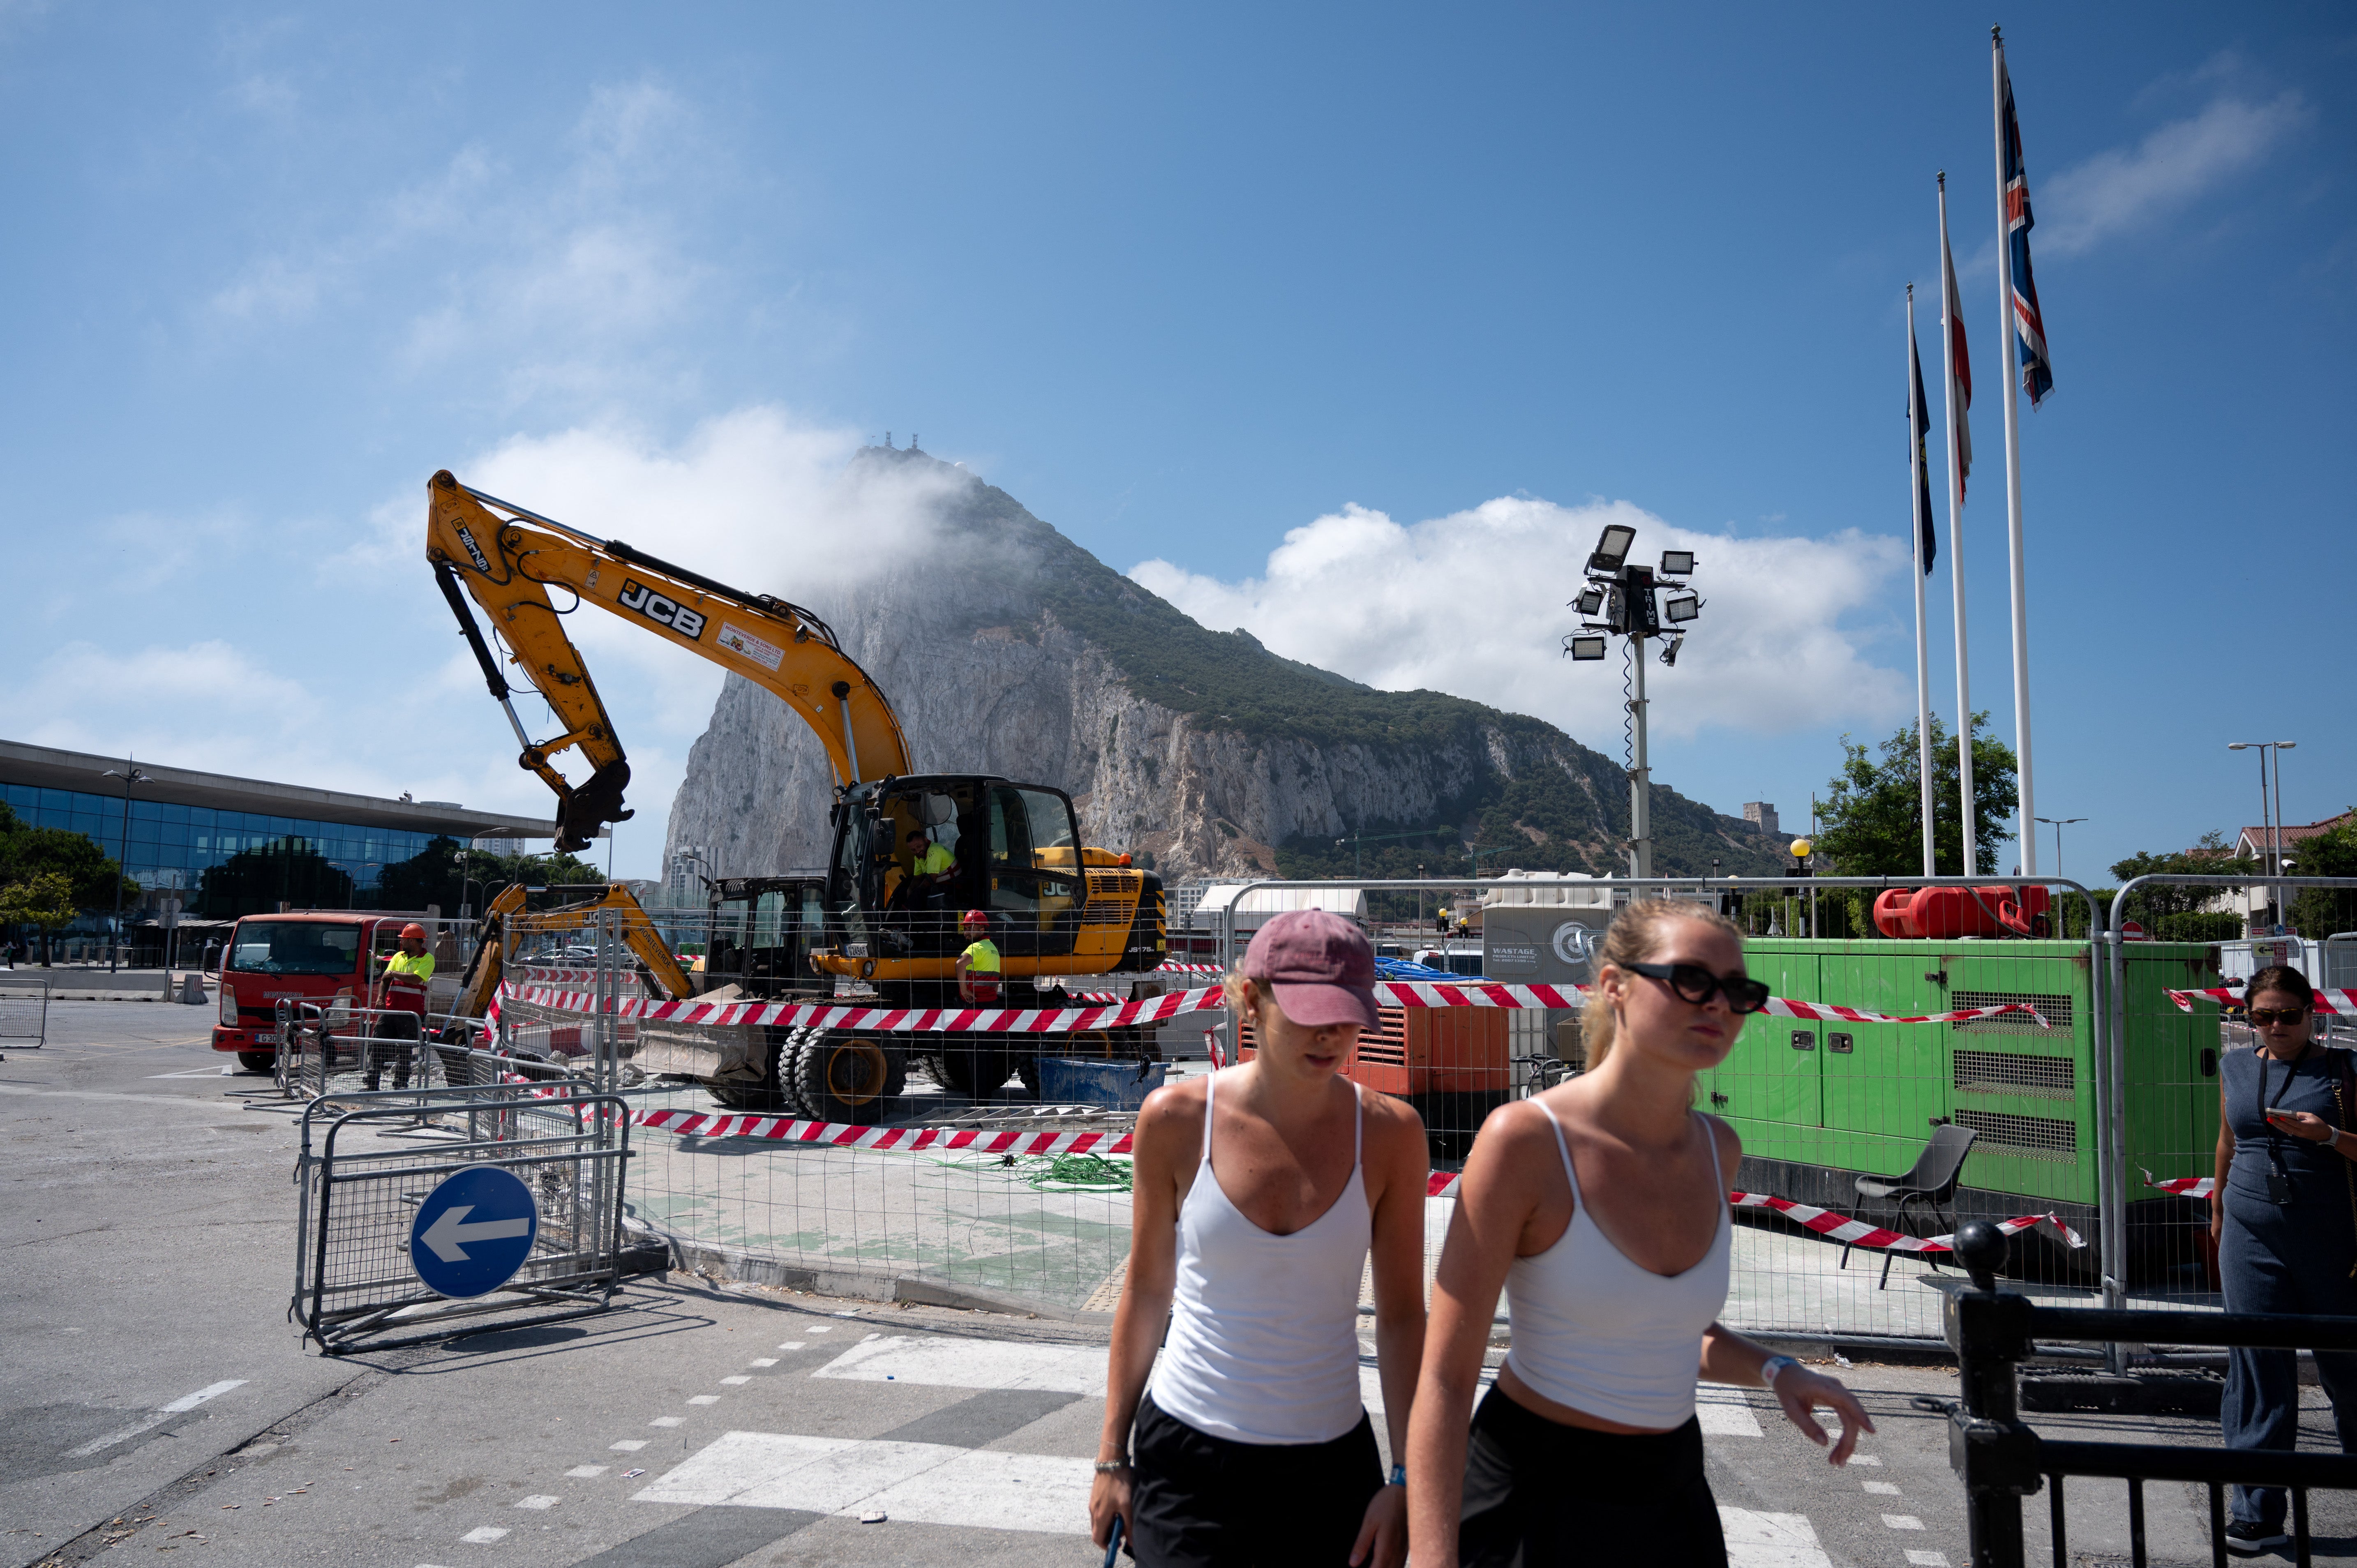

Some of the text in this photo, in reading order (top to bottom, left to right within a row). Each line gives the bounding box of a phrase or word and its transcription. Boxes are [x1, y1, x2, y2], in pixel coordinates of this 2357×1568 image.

[621, 588, 703, 637] JCB
[1644, 588, 1655, 625] TRIME
[725, 625, 755, 642] MONTEVERDE
[760, 641, 772, 650] SONS
[772, 648, 782, 656] LTD.
[764, 648, 780, 659] DEMOLITION
[751, 655, 768, 664] GIBRALTAR
[638, 924, 672, 969] MONTEVERDE
